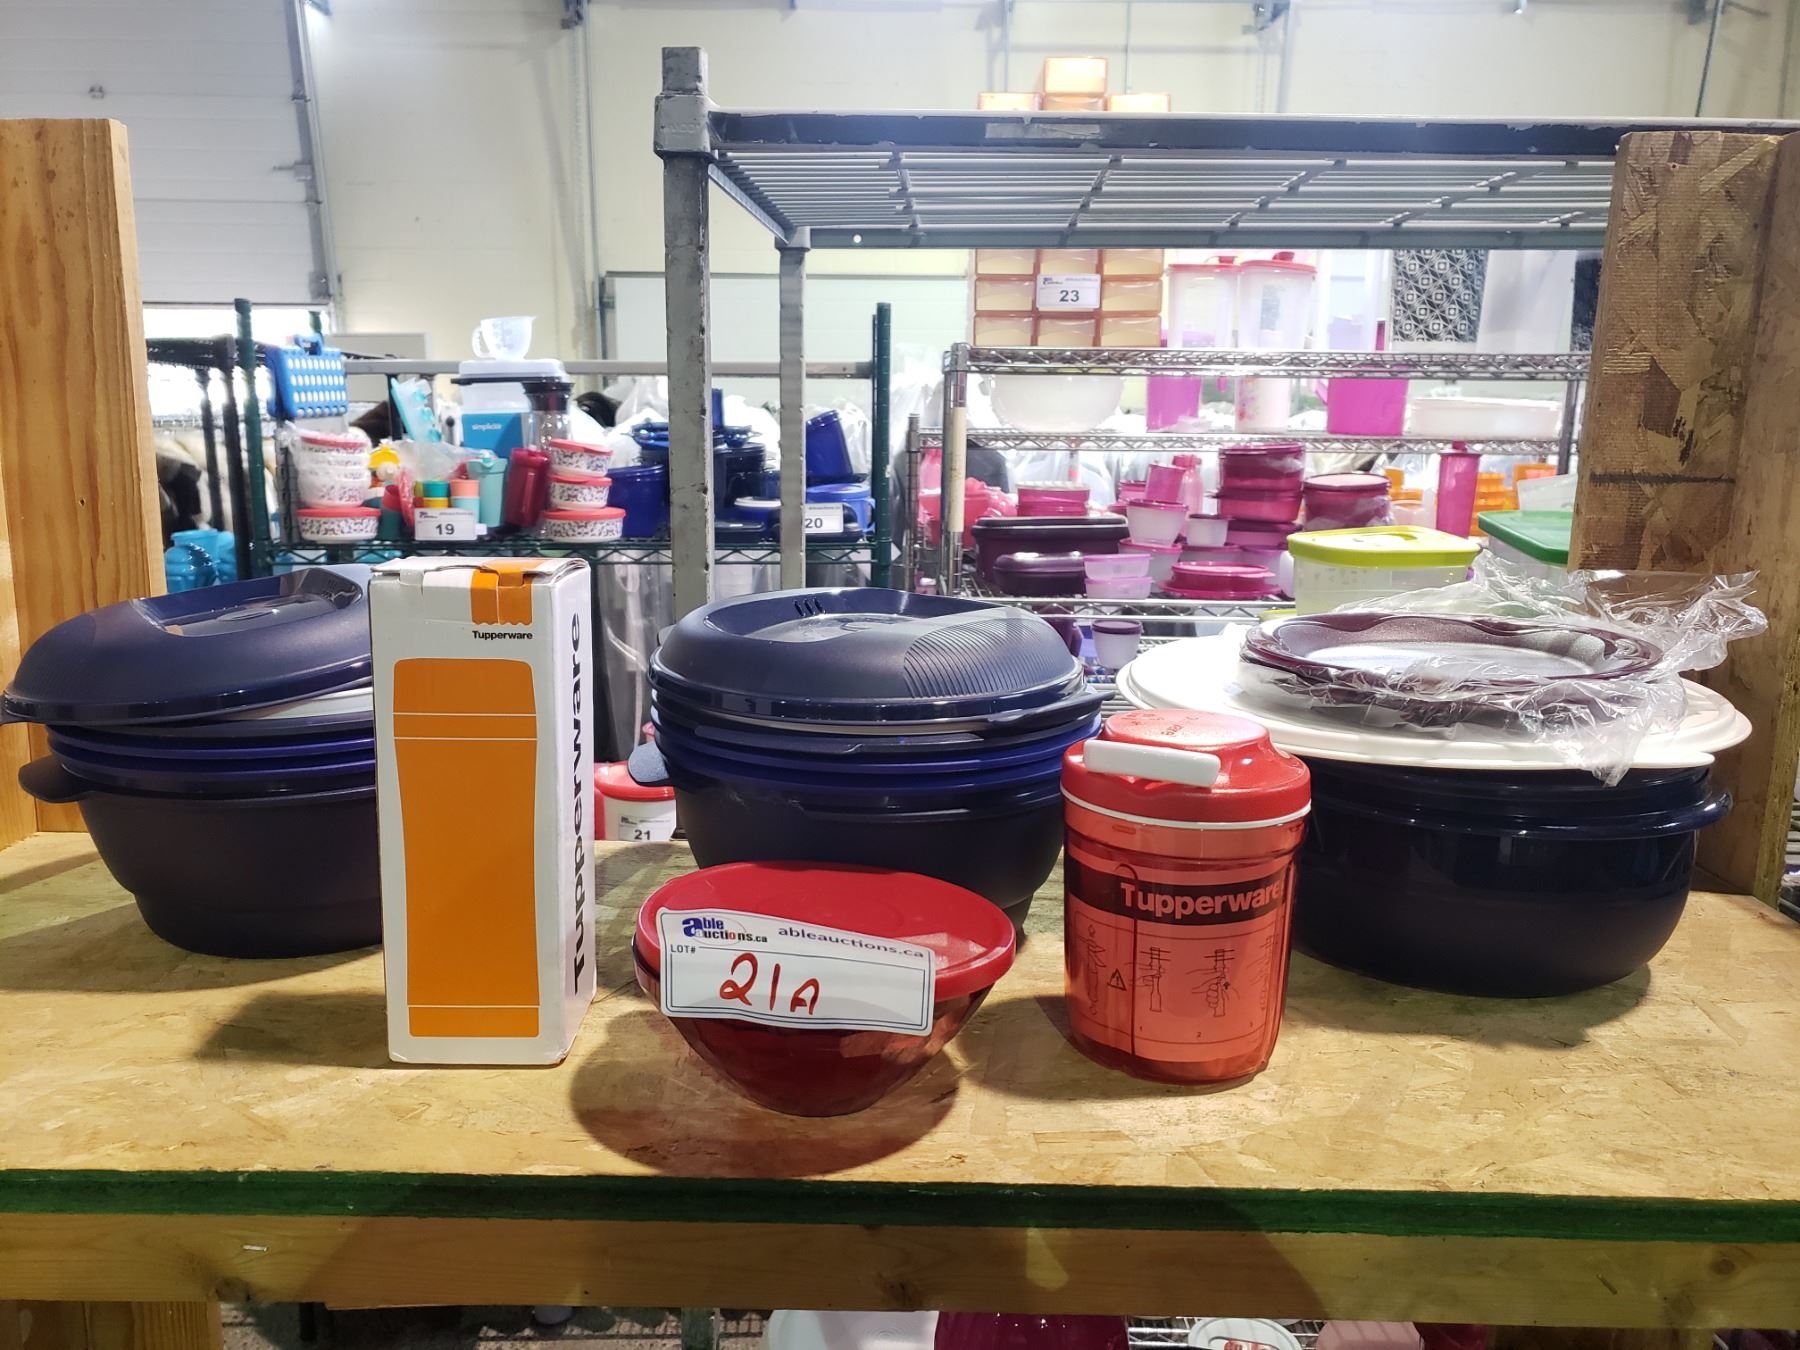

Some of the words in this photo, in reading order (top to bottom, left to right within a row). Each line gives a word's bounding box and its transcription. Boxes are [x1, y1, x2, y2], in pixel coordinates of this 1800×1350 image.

[1059, 290, 1080, 302] 23
[804, 517, 823, 528] 20
[435, 523, 455, 535] 19
[472, 630, 533, 640] Tupperware
[571, 612, 585, 996] Tupperware
[634, 829, 651, 840] 21
[1120, 880, 1283, 919] Tupperware
[682, 917, 724, 937] able
[778, 926, 925, 959] ableauctions.ca
[670, 944, 696, 954] LOT#
[719, 951, 820, 1016] 21A
